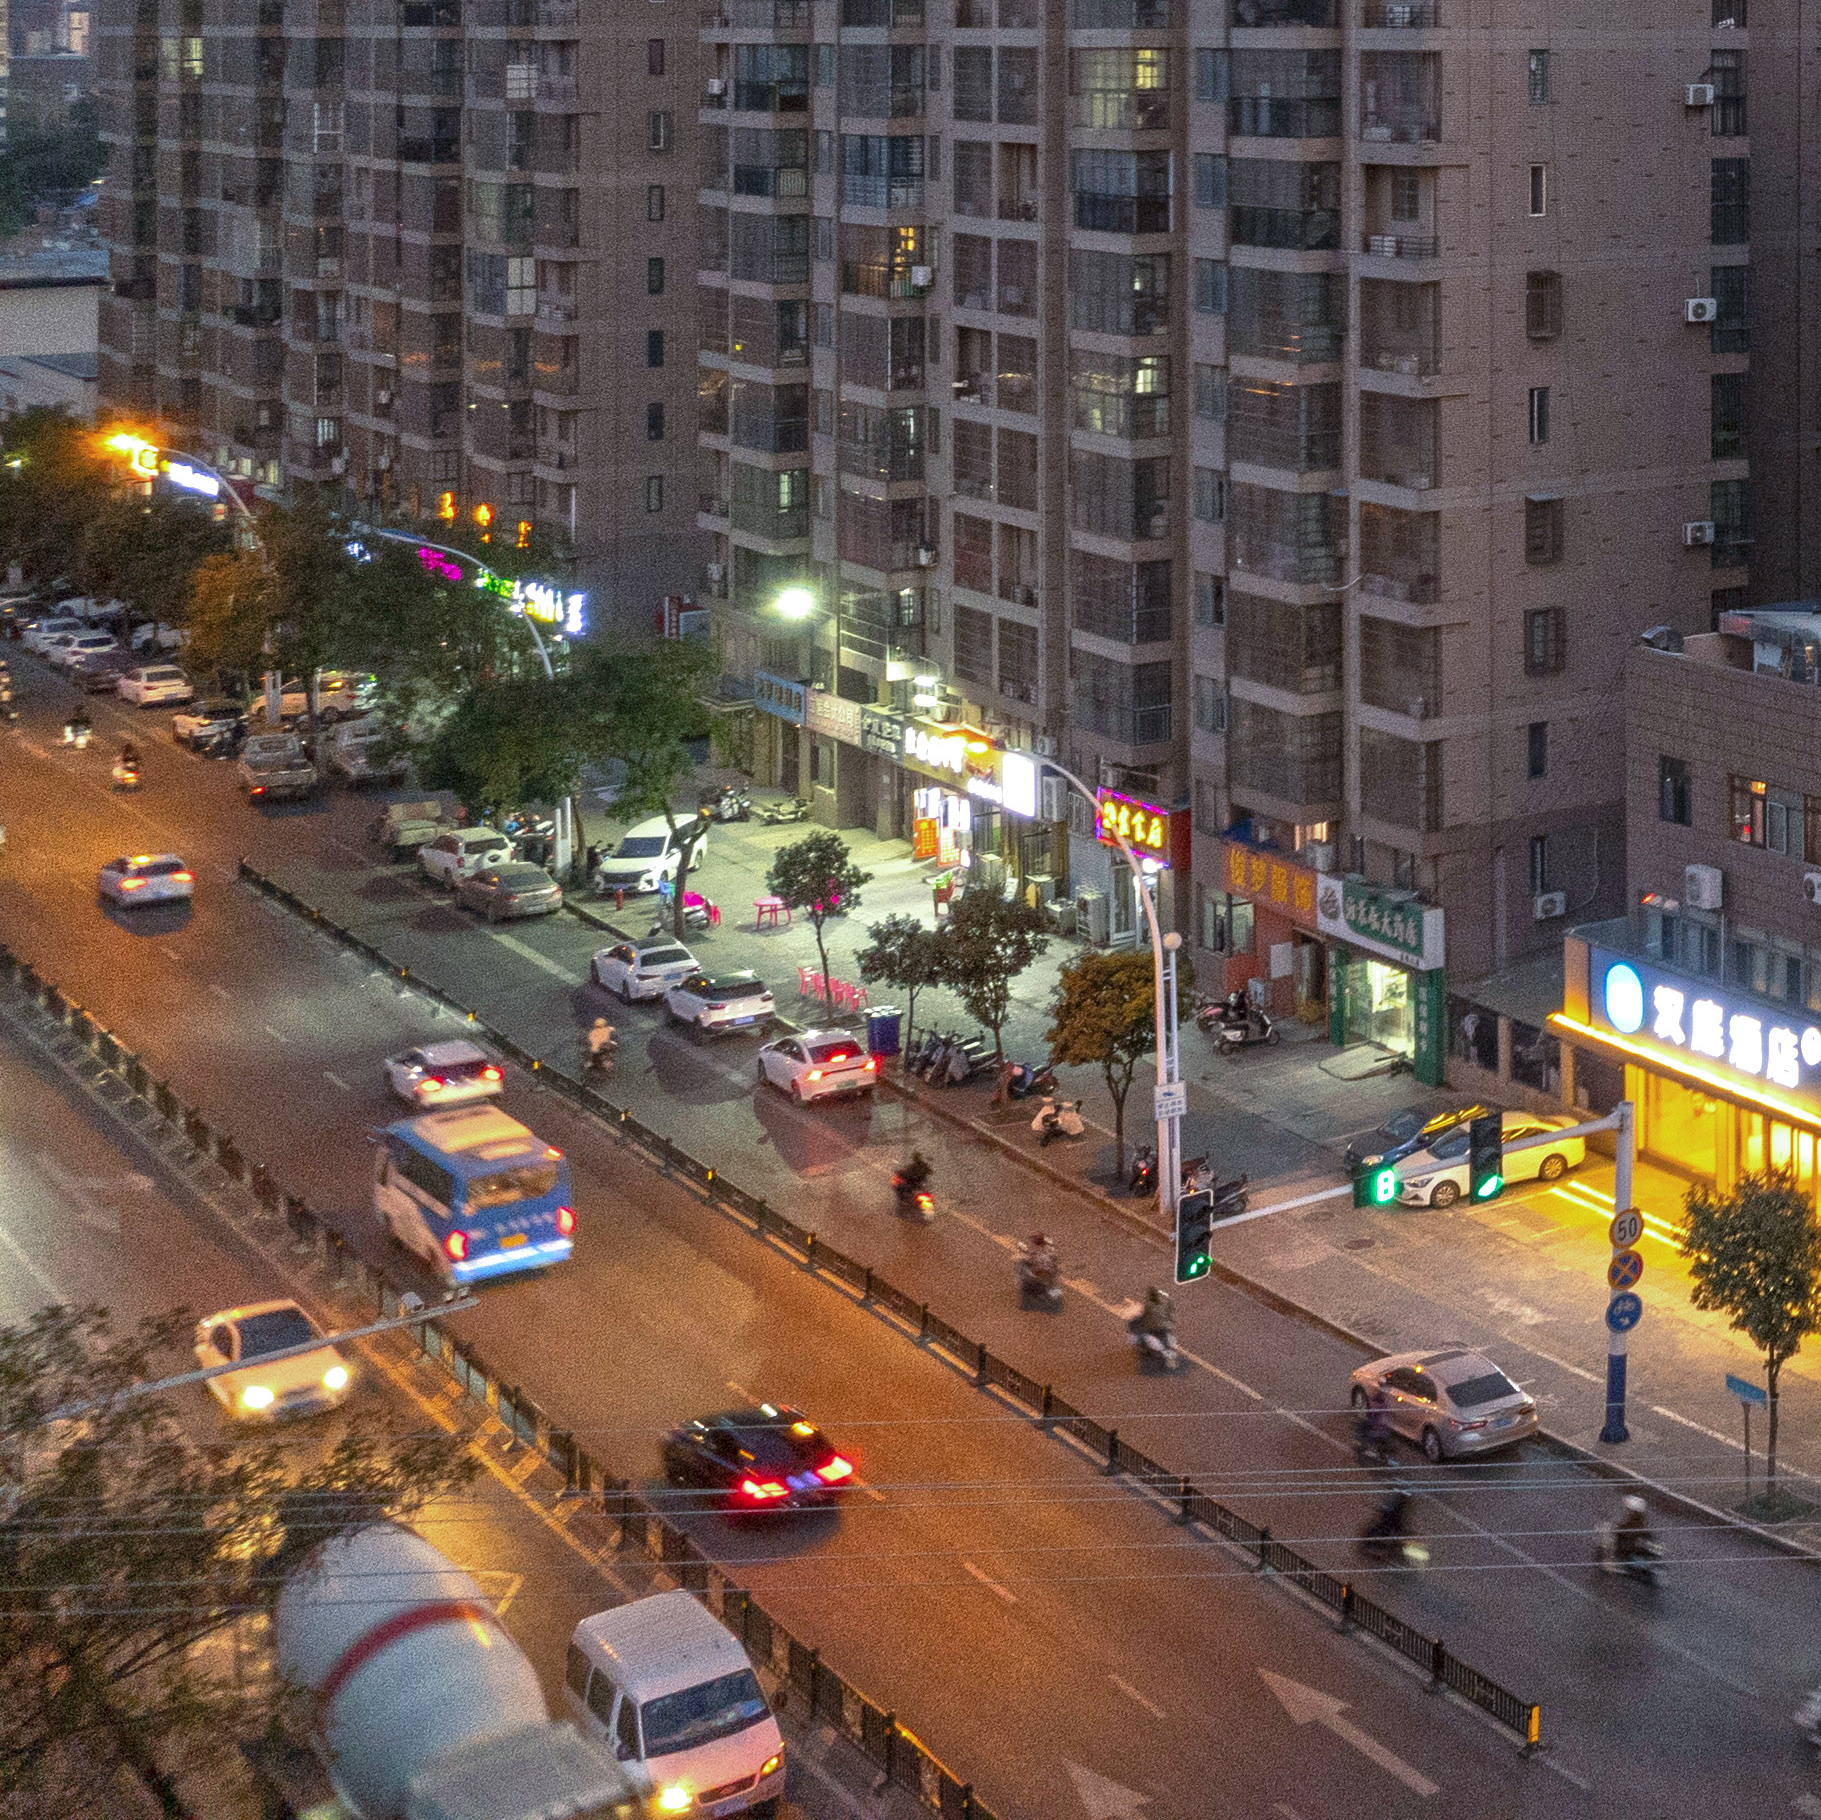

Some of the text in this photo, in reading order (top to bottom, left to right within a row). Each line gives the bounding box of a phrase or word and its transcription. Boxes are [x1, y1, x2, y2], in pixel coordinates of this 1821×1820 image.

[1653, 984, 1800, 1089] 汉庭酒店
[1375, 1169, 1396, 1202] 8
[1617, 1216, 1638, 1242] 50
